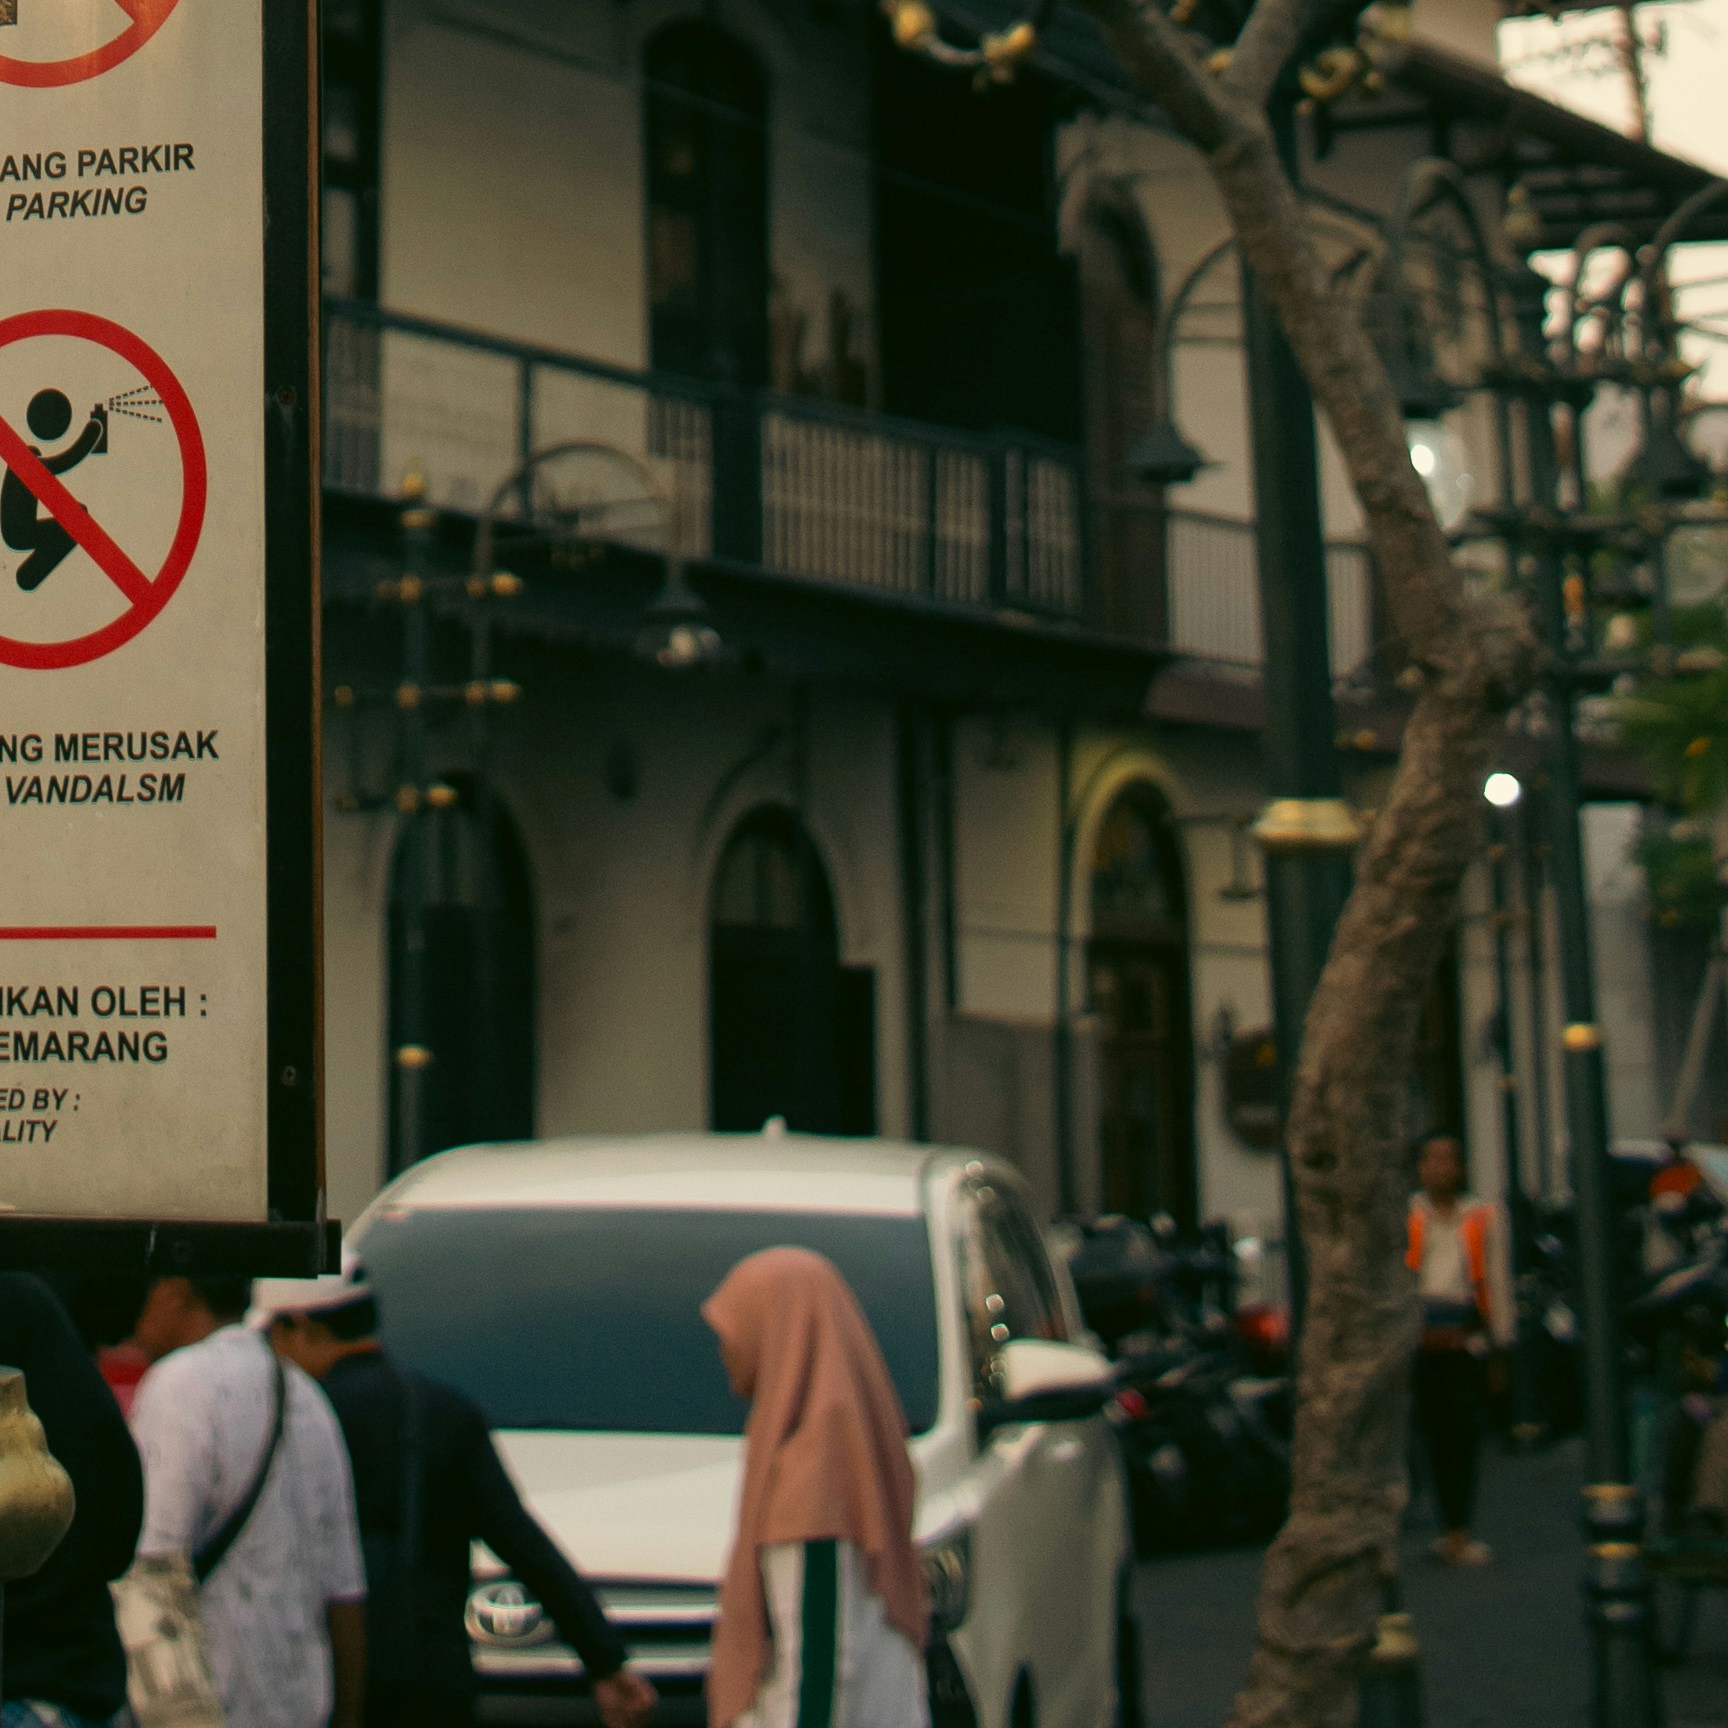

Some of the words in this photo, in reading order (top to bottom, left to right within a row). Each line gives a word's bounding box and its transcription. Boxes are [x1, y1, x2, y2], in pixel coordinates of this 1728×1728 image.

[77, 143, 196, 178] PARKIR
[5, 185, 148, 222] PARKING
[54, 729, 220, 762] MERUSAK
[5, 772, 186, 805] VANDALSM
[90, 985, 186, 1017] OLEH
[32, 1088, 69, 1111] BY
